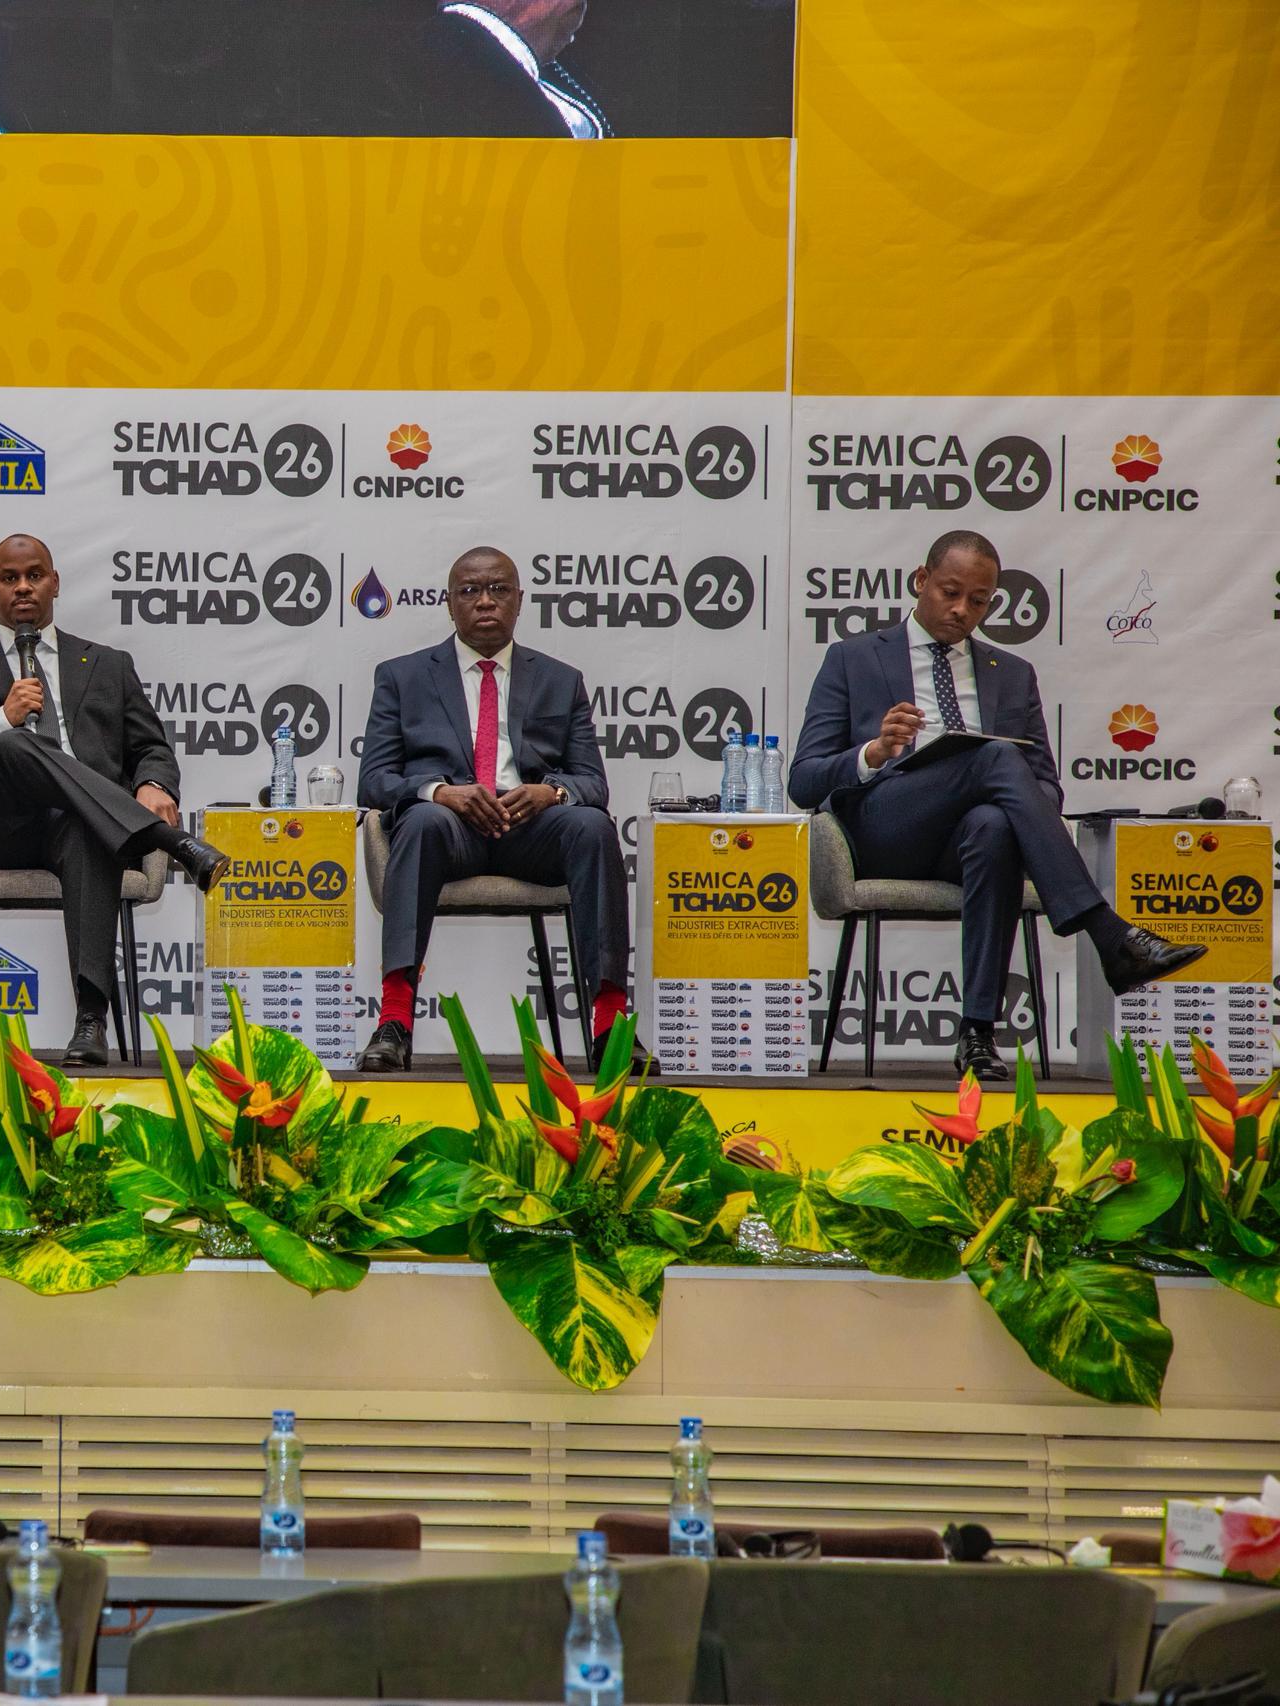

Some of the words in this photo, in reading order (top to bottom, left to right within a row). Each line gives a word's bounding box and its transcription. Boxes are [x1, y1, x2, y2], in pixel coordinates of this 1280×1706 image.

[114, 422, 258, 453] SEMICA
[534, 425, 679, 455] SEMICA
[808, 435, 968, 466] SEMICA
[275, 442, 322, 479] 26
[696, 444, 744, 481] 26
[987, 455, 1039, 492] 26
[113, 459, 261, 495] TCHAD
[353, 476, 465, 498] CNPCIC
[533, 462, 683, 498] TCHAD
[807, 473, 972, 510] TCHAD
[1074, 489, 1199, 511] CNPCIC
[113, 551, 257, 582] SEMICA
[532, 554, 678, 585] SEMICA
[273, 572, 320, 608] 26
[397, 588, 449, 606] ARSA
[695, 574, 743, 611] 26
[806, 568, 918, 600] SEMI
[112, 589, 260, 625] TCHAD
[531, 592, 681, 628] TCHAD
[985, 588, 1037, 626] 26
[805, 606, 902, 644] TCH
[273, 703, 319, 739] 26
[693, 706, 741, 742] 26
[163, 720, 259, 755] HAD
[594, 724, 680, 760] HAD
[1071, 758, 1196, 781] CNPCIC
[220, 881, 307, 901] TCHAD
[314, 871, 342, 891] 26
[668, 872, 754, 889] SEMICA
[764, 883, 792, 903] 26
[1131, 874, 1218, 891] SEMICA
[1228, 885, 1257, 907] 26
[220, 909, 275, 919] INDUSTRIES
[668, 893, 756, 912] TCHAD
[1131, 895, 1220, 915] TCHAD
[668, 921, 724, 930] INDUSTRIES
